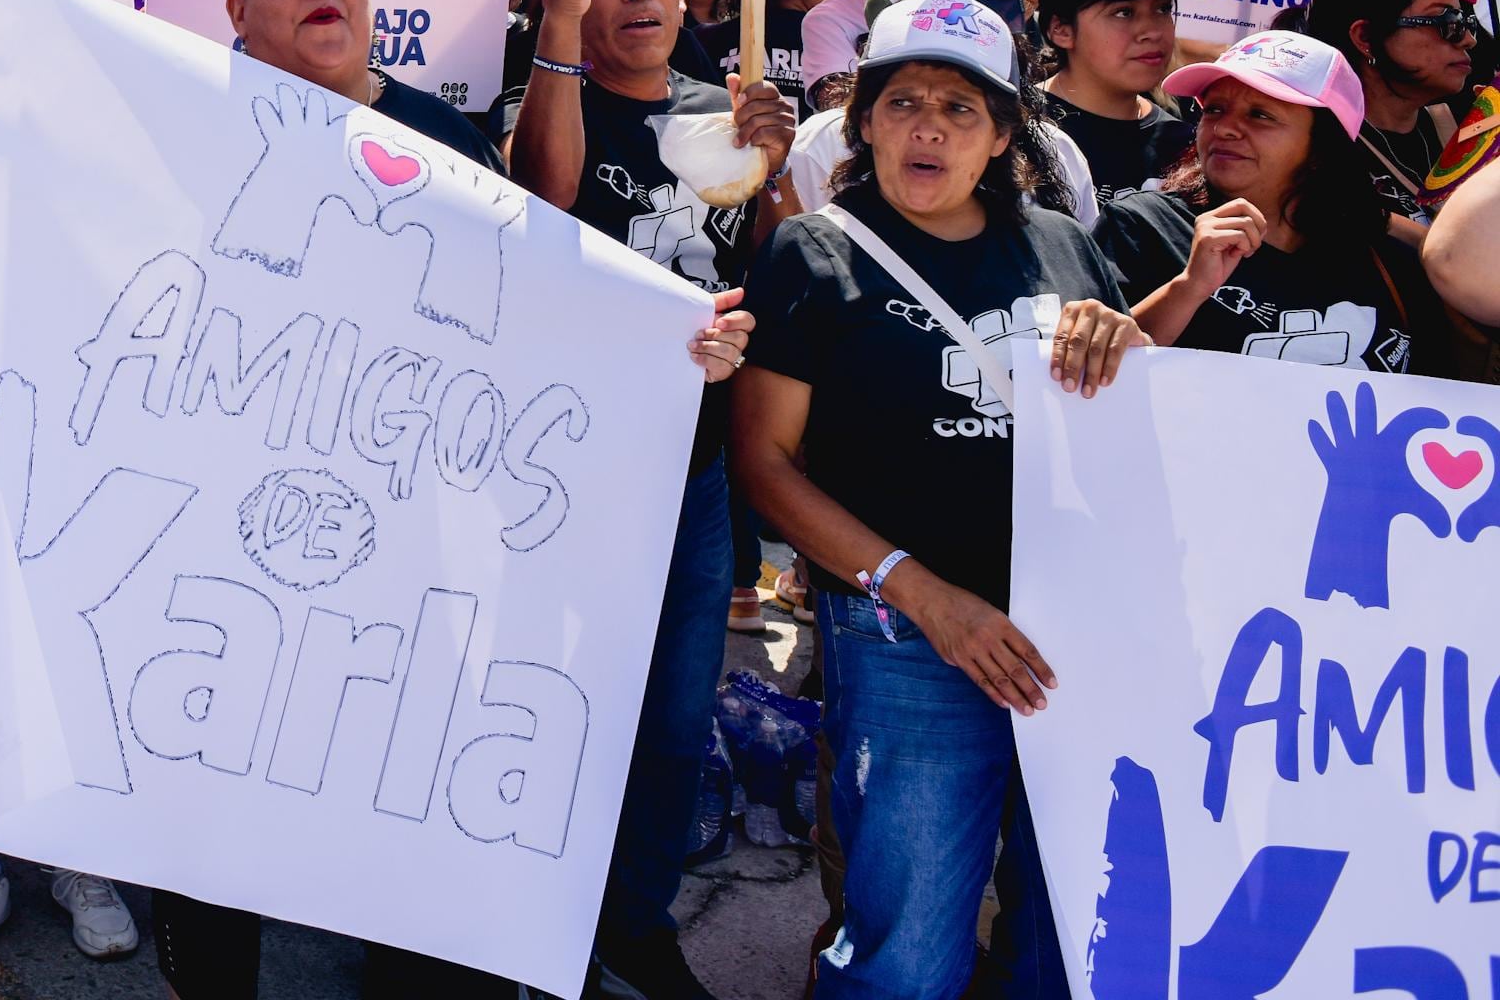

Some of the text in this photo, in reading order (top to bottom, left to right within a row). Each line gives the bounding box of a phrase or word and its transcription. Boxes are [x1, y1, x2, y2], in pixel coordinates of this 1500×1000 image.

[69, 250, 589, 553] AMIGOS
[263, 485, 349, 560] DE
[1194, 607, 1500, 822] AMI
